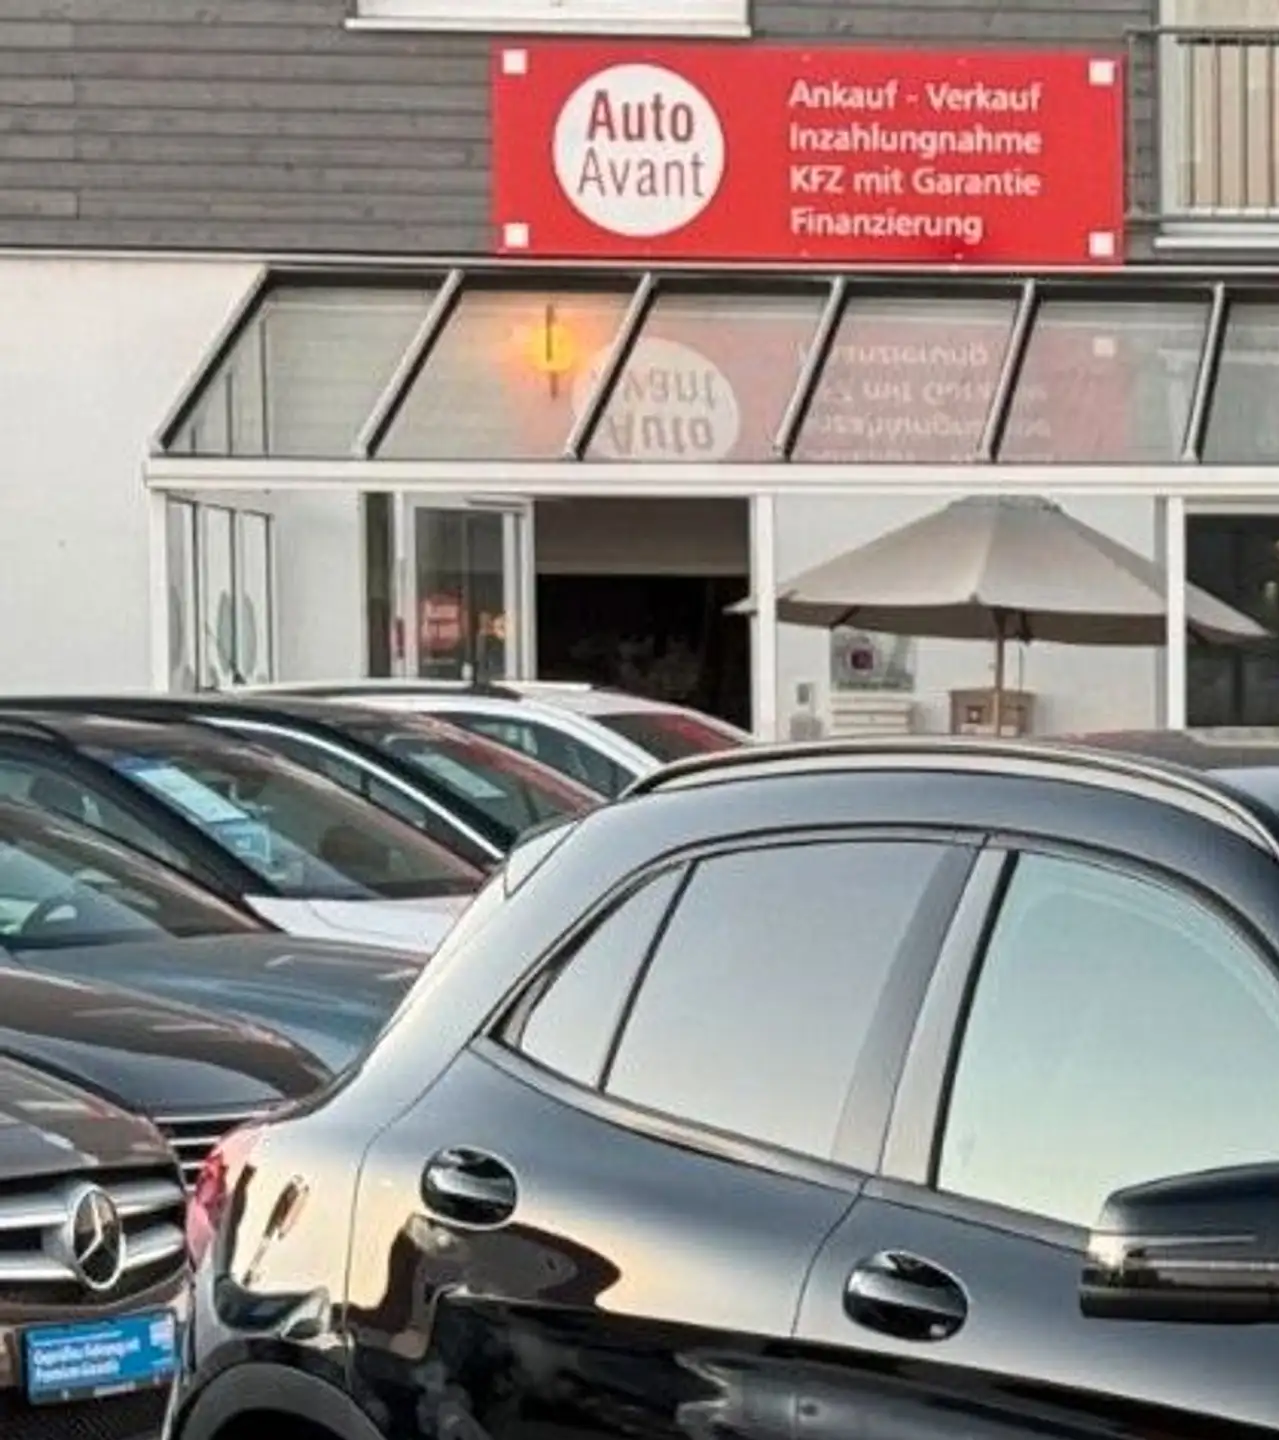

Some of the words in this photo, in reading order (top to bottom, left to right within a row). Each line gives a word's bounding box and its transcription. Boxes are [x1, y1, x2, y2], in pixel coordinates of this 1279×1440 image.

[789, 80, 898, 111] Ankauf
[926, 83, 1043, 112] Verkauf
[586, 89, 695, 142] Auto
[789, 124, 1043, 157] Inzahlungnahme
[576, 147, 706, 198] Avant
[789, 167, 844, 195] KFZ
[853, 168, 905, 195] mit
[912, 168, 1042, 197] Garantie
[789, 208, 983, 244] Finanzierung
